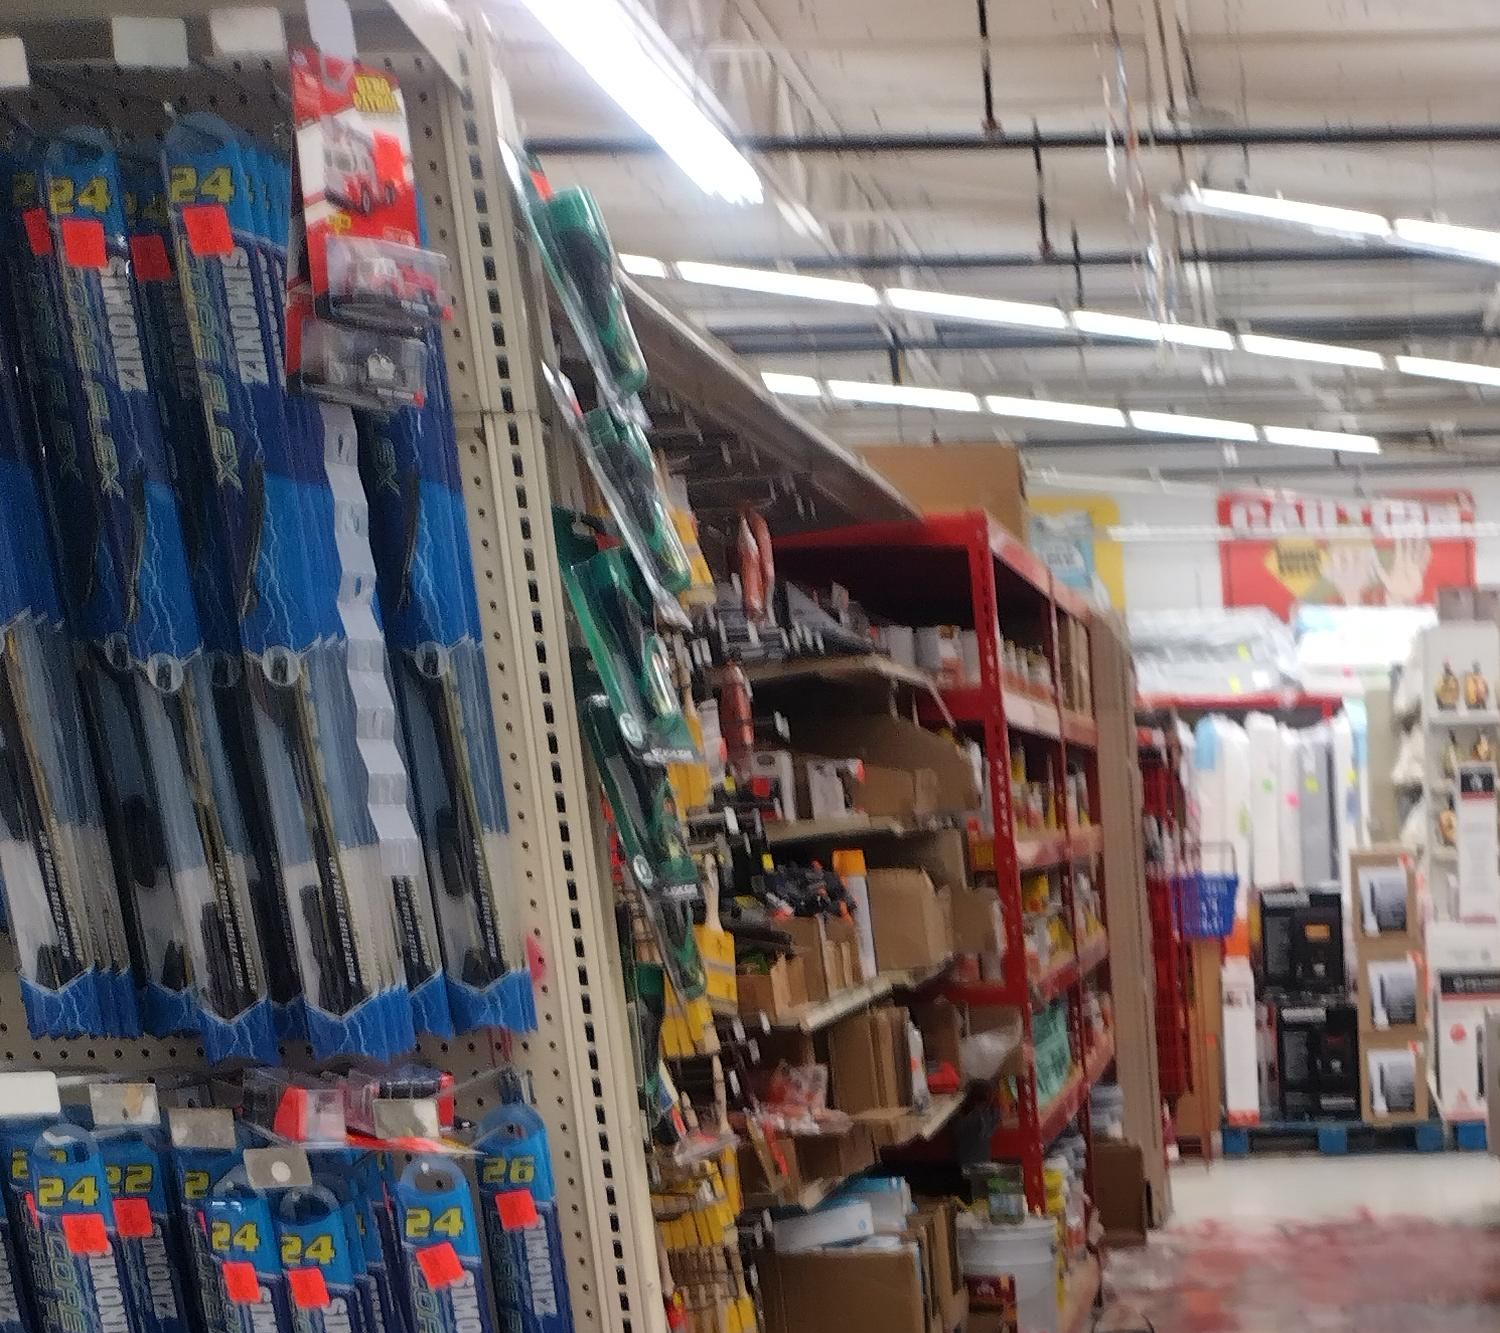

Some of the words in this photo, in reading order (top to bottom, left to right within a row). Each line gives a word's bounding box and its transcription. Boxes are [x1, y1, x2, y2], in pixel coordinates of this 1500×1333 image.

[50, 176, 111, 214] 24
[171, 167, 233, 201] 24
[99, 256, 148, 392] SIMONIZ
[220, 247, 269, 385] SIMONIZ
[184, 1169, 210, 1199] 2
[483, 1157, 535, 1184] 26
[38, 1175, 99, 1207] 24
[211, 1221, 260, 1253] 24
[405, 1206, 464, 1238] 24
[280, 1234, 336, 1264] 24
